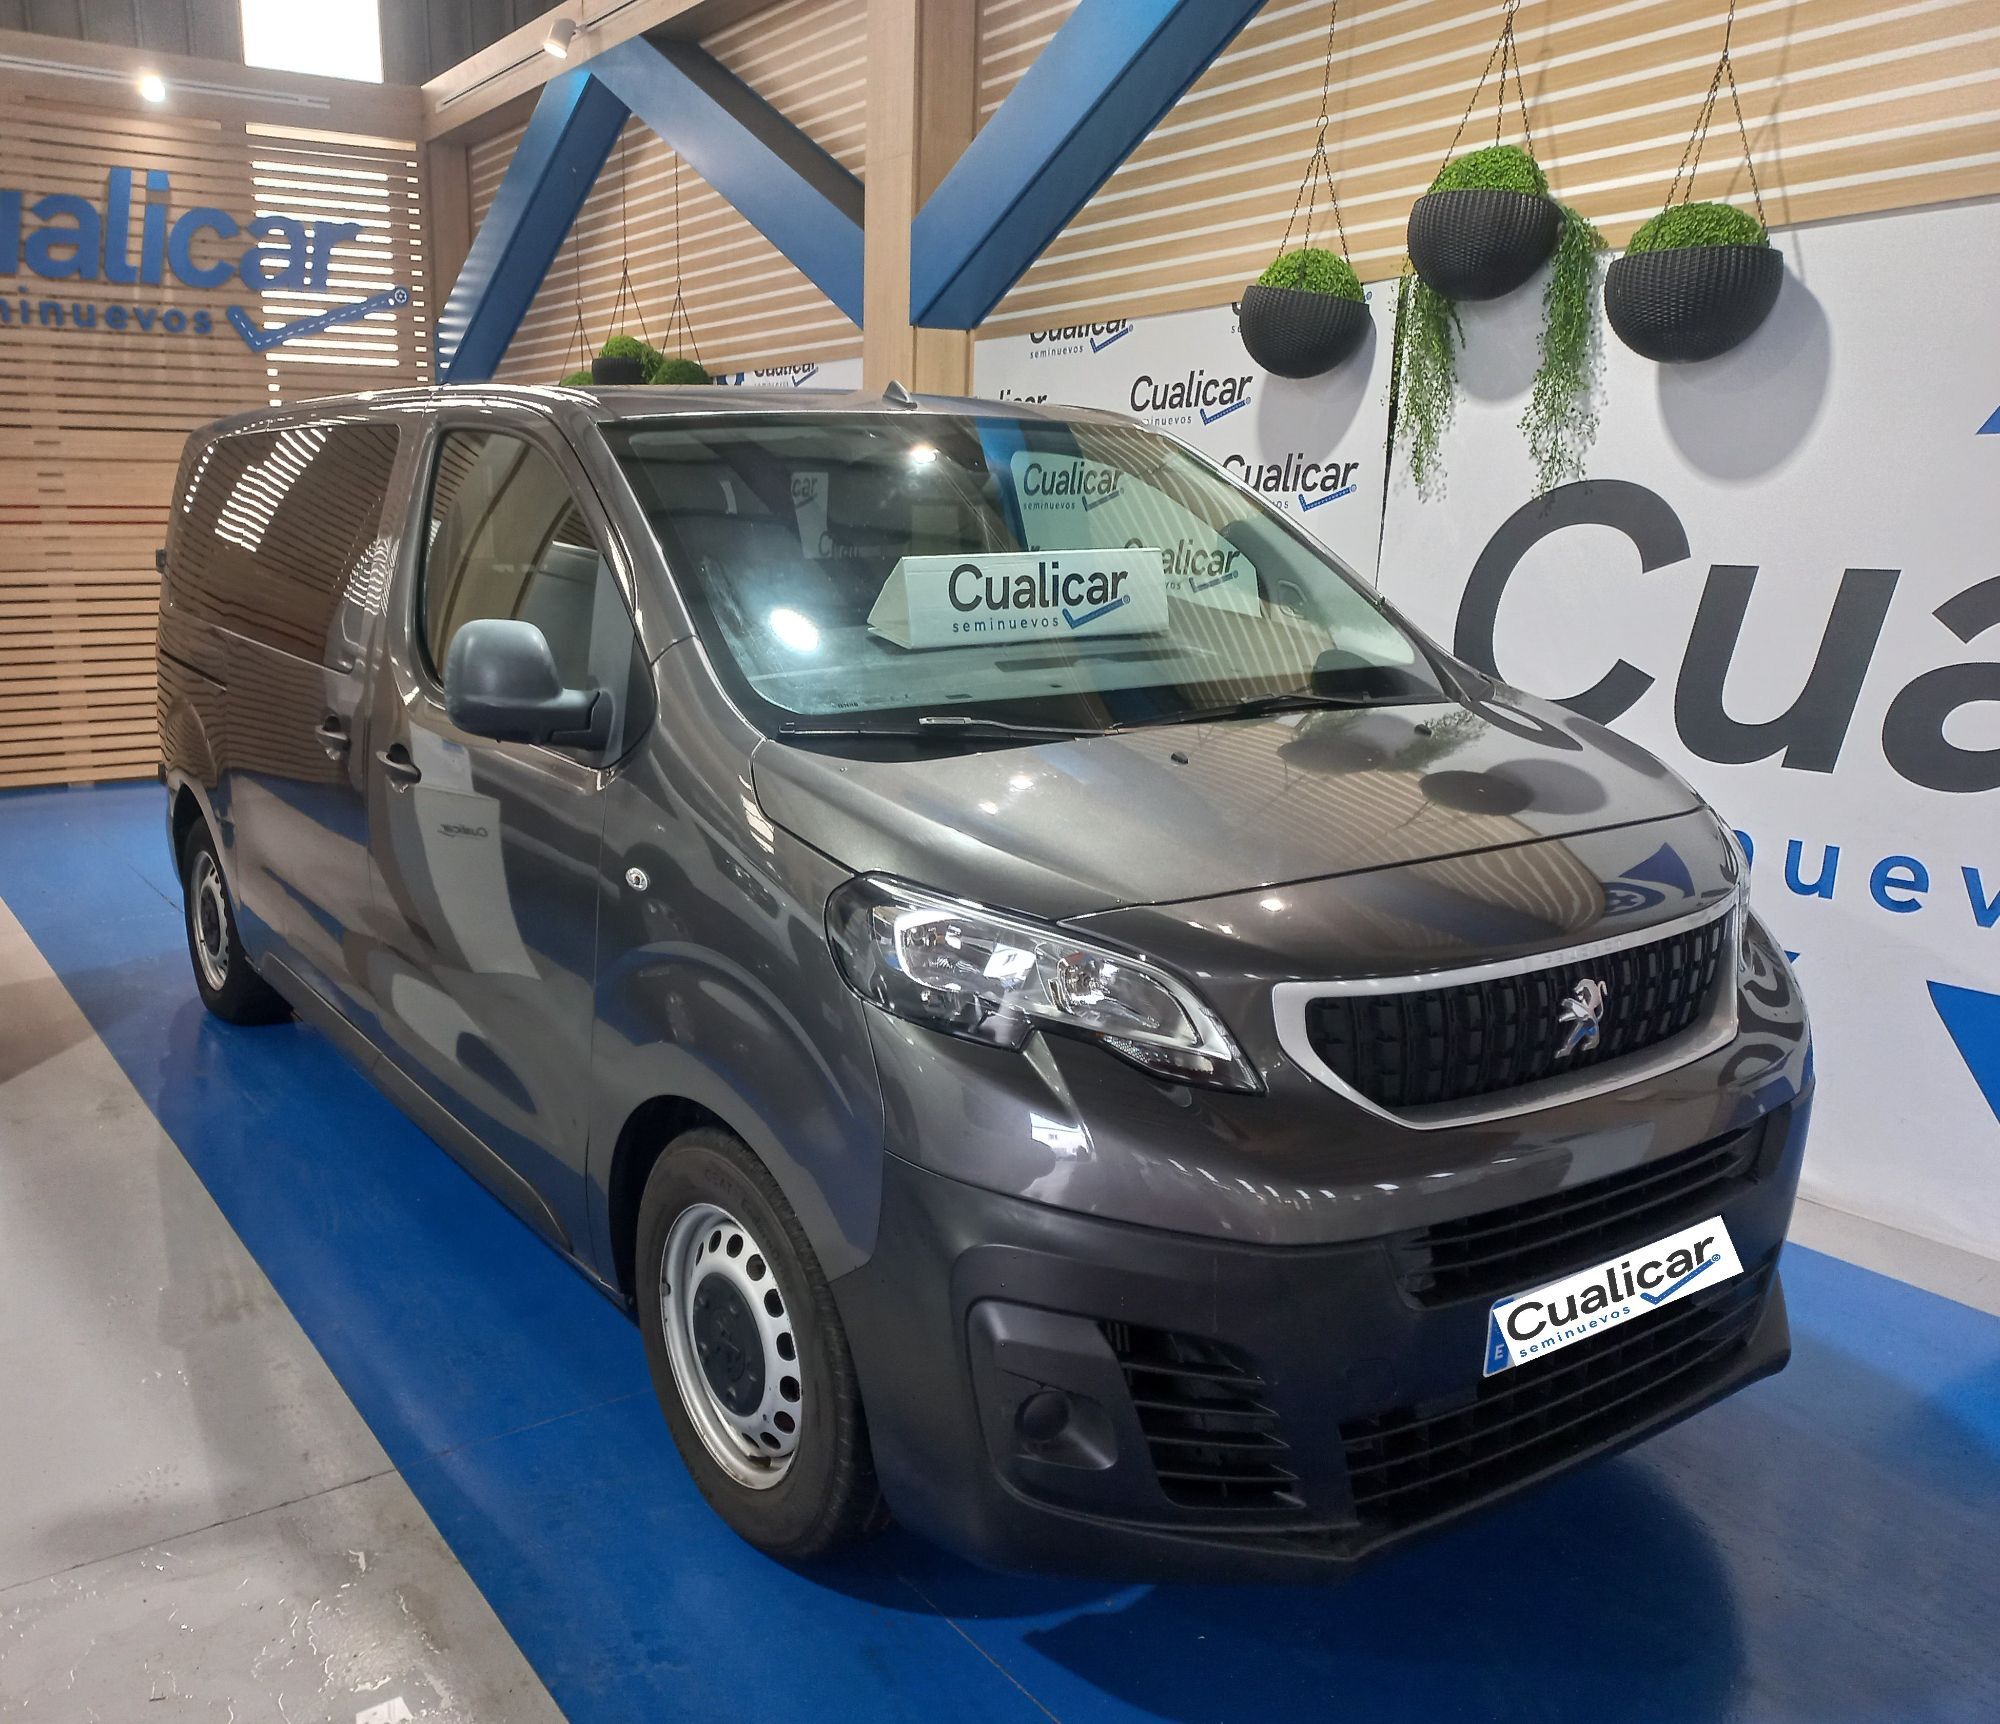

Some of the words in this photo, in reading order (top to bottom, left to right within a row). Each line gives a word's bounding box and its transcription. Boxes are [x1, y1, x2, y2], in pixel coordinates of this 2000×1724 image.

[0, 165, 361, 292] alicar
[1030, 345, 1084, 359] seminuevos
[1130, 369, 1253, 411] Cualicar
[1024, 462, 1124, 496] Cualicar
[1024, 501, 1076, 510] seminuevos
[949, 561, 1128, 611] Cualicar
[953, 617, 1059, 632] seminuevos
[1494, 1344, 1505, 1361] E
